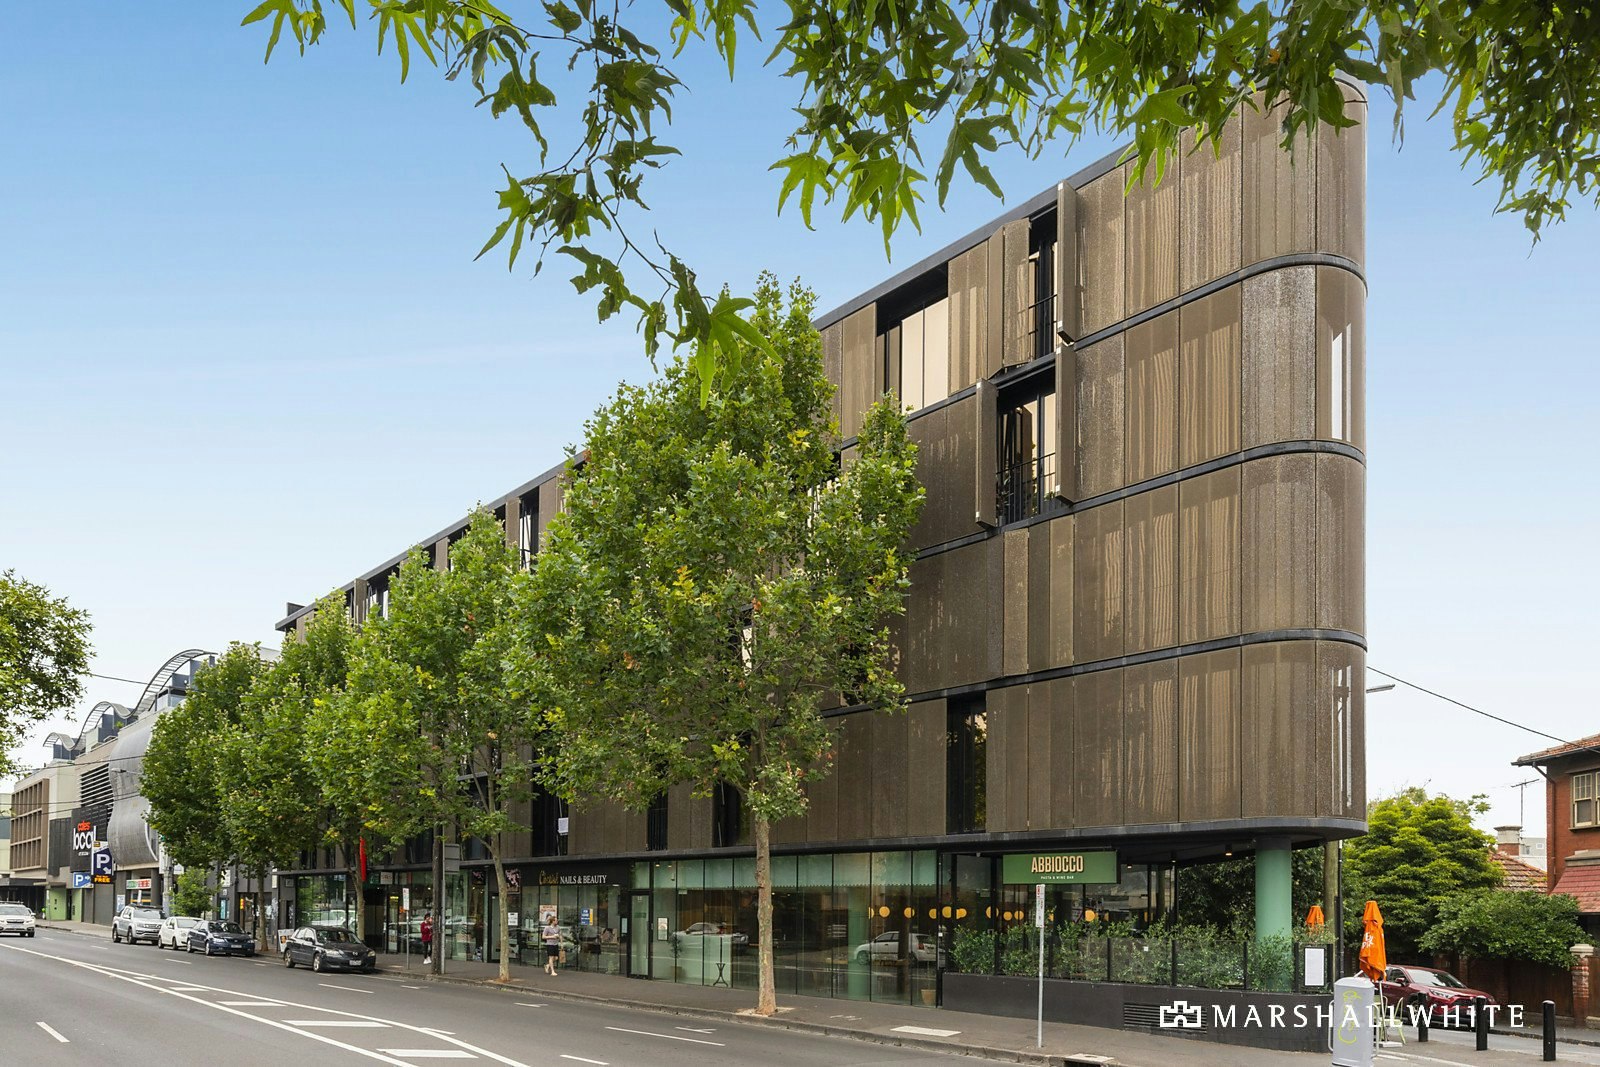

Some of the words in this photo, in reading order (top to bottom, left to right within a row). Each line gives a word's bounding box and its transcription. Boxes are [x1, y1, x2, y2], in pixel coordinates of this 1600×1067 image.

[96, 854, 110, 868] P
[1031, 855, 1084, 873] ABBIOCCO
[75, 874, 84, 886] P
[560, 875, 577, 884] NAILS
[577, 875, 582, 884] &
[583, 874, 607, 884] BEAUTY
